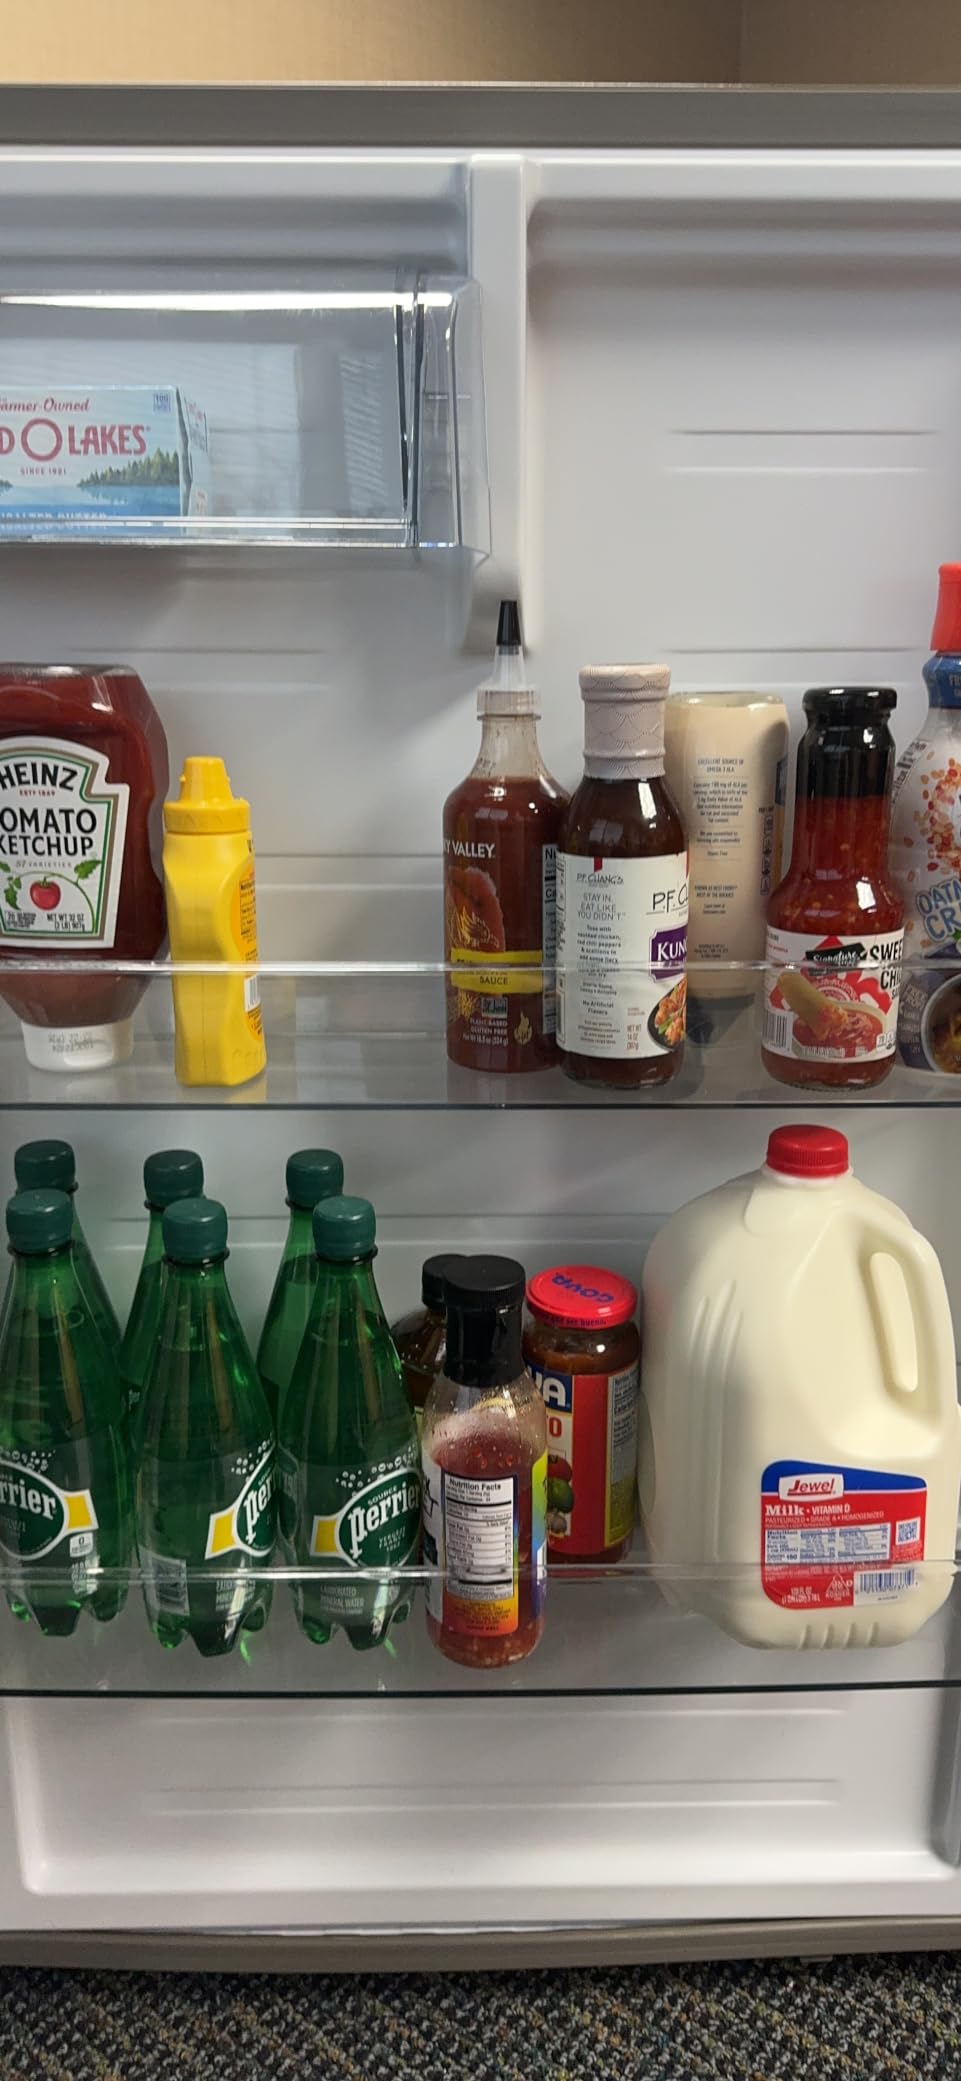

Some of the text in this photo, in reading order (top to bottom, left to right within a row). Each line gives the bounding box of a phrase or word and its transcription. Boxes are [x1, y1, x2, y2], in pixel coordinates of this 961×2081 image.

[21, 417, 63, 462] O
[67, 425, 147, 456] LAKES
[0, 761, 78, 791] HEINZ
[584, 893, 601, 902] STAY
[581, 903, 616, 913] EAT LIKE
[578, 911, 592, 919] YOU
[480, 976, 508, 984] SAUCE
[449, 1478, 480, 1491] Nutrition
[787, 1478, 836, 1496] Jewel
[765, 1503, 851, 1516] Milk VITAMIN D
[765, 1516, 805, 1525] PASTEURIZED
[810, 1514, 831, 1523] GRADE
[841, 1511, 884, 1521] HOMOGENIZED
